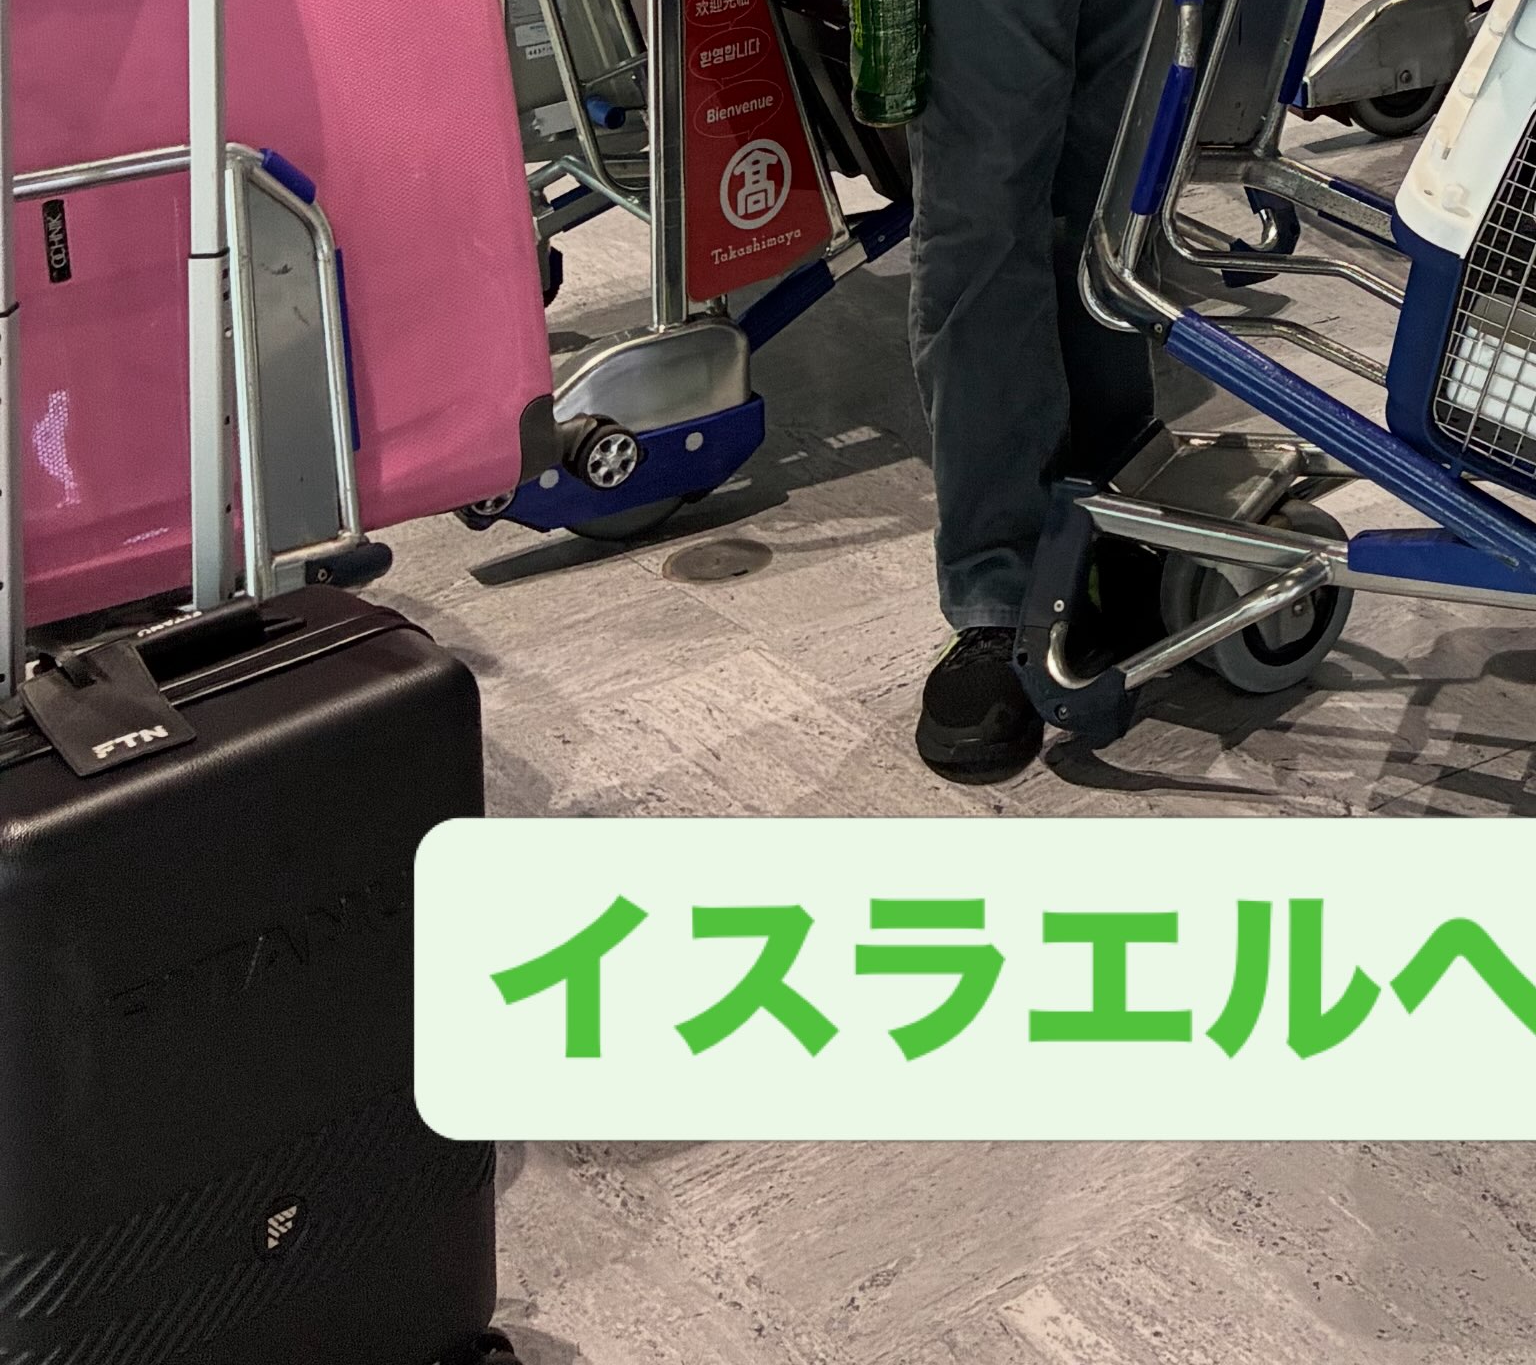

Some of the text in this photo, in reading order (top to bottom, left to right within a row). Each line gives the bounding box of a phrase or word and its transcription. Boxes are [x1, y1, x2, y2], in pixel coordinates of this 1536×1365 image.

[699, 36, 761, 69] 환영합니다
[706, 94, 774, 124] Bienvenue
[47, 212, 67, 269] OCHNIK
[710, 228, 802, 266] Takashimaya
